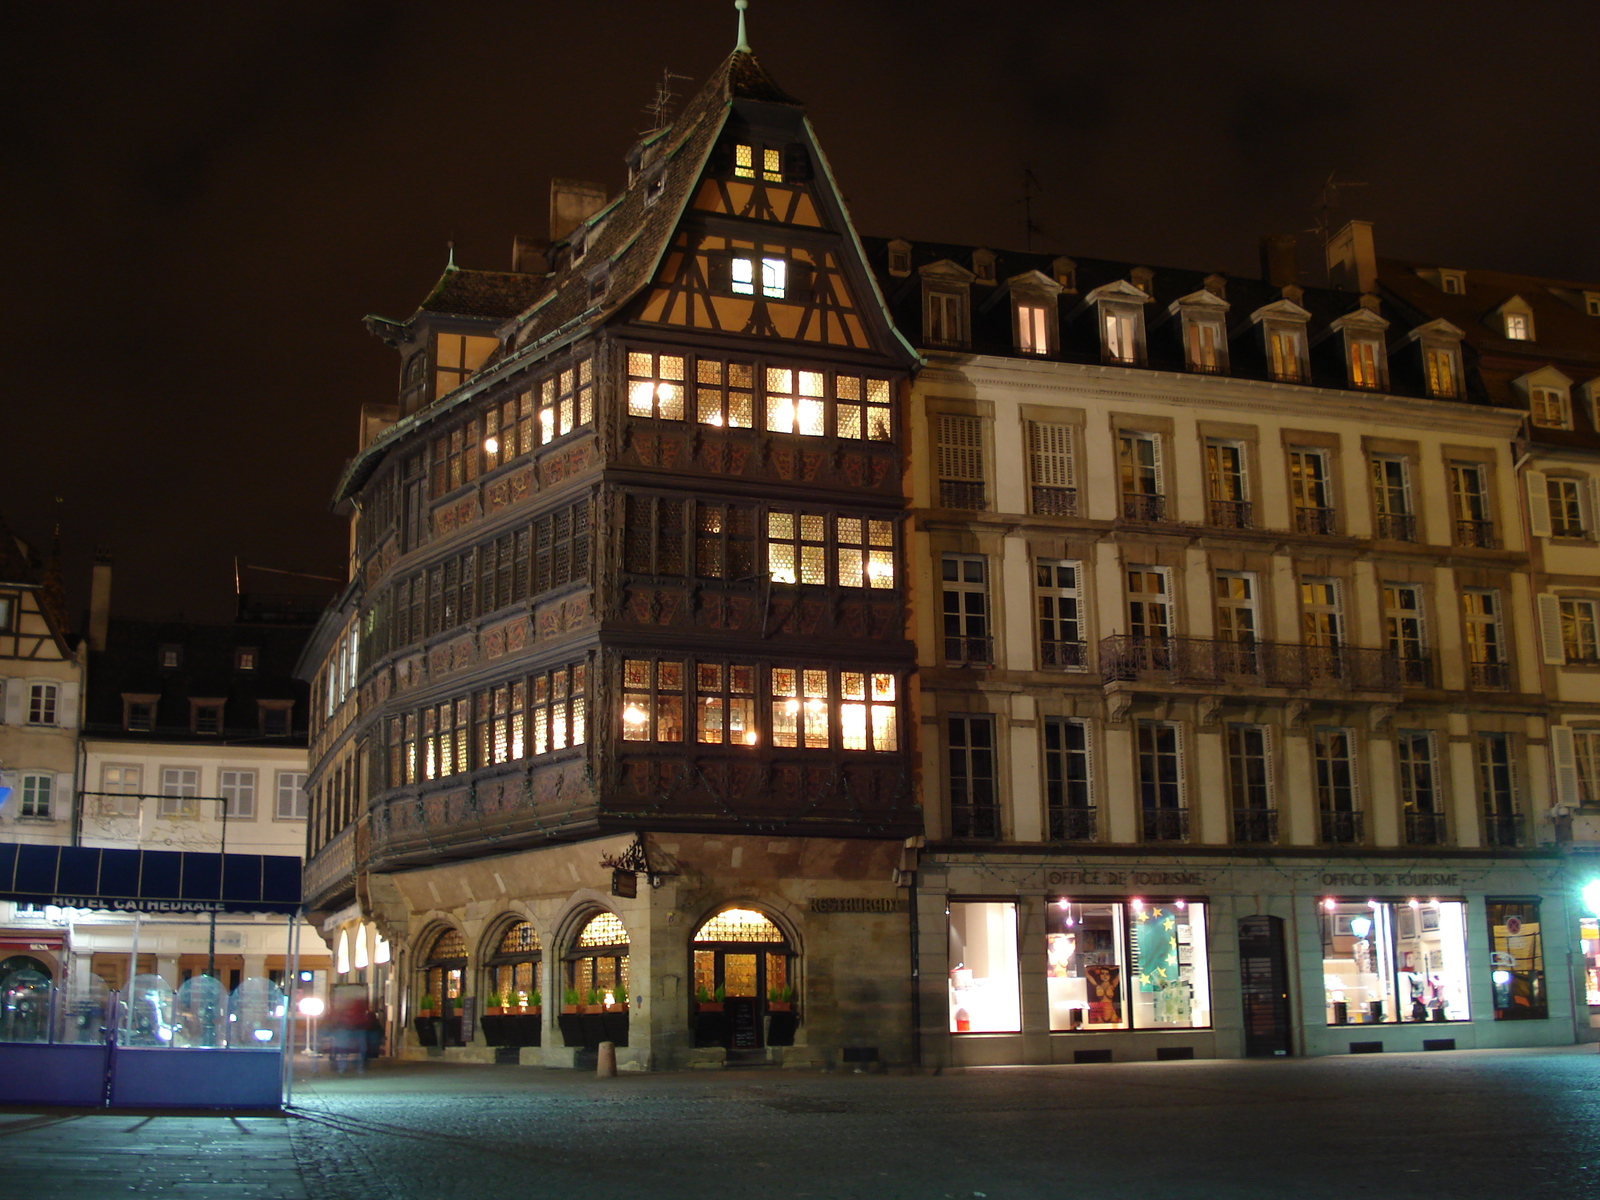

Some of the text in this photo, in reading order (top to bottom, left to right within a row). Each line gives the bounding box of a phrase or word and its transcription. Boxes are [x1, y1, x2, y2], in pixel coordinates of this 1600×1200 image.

[1049, 872, 1203, 886] OFFICE DE TOURISME
[1322, 873, 1460, 887] OFFICE DE TOURISME
[51, 896, 109, 909] HOTEL
